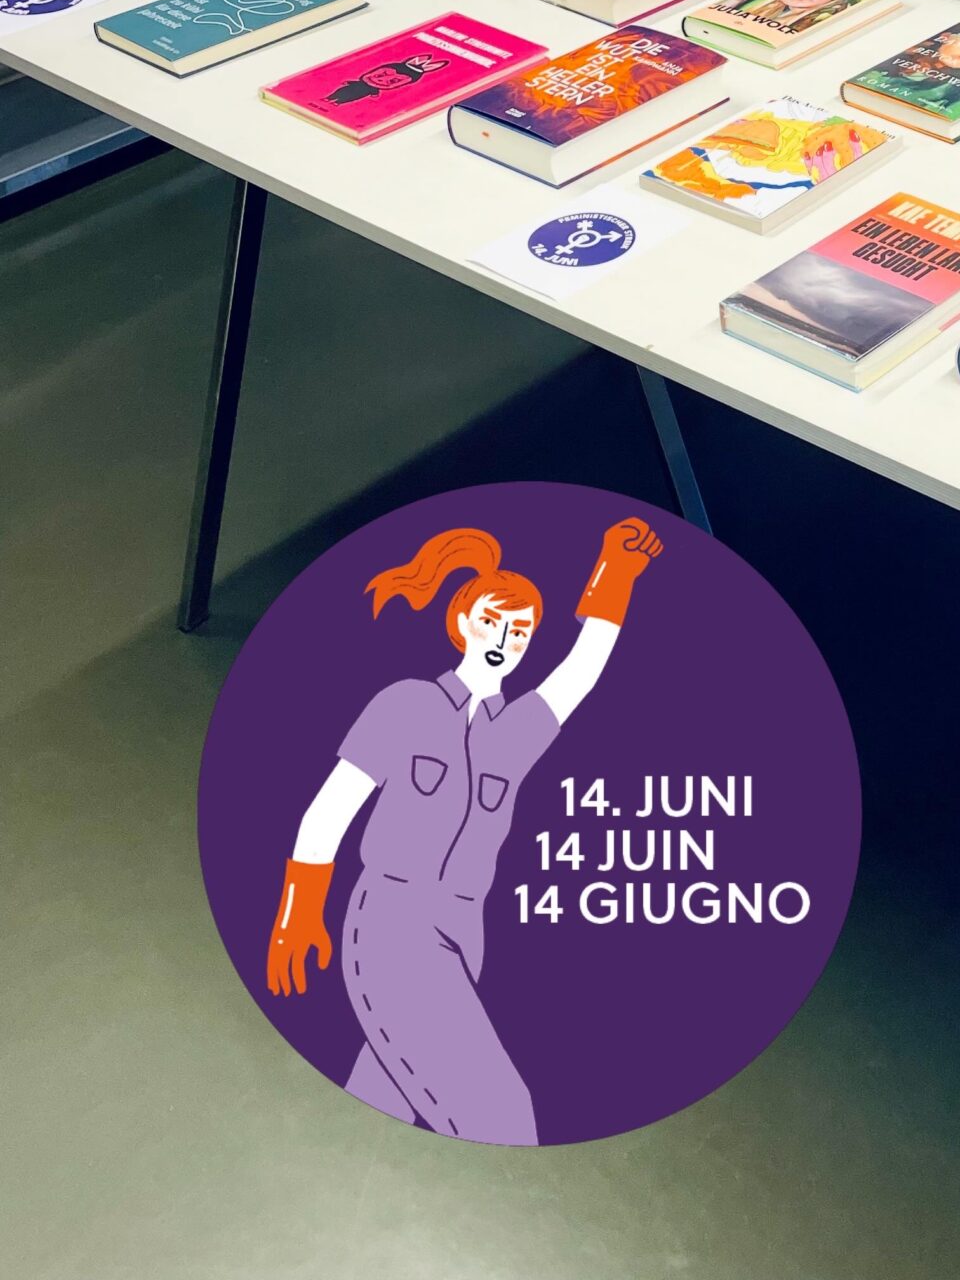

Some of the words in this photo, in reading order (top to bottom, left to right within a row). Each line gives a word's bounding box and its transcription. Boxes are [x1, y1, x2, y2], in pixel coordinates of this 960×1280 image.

[708, 4, 751, 20] JULIA
[754, 15, 800, 36] WOLF
[592, 39, 639, 61] WUT
[633, 38, 671, 57] DIE
[586, 52, 624, 70] IST
[634, 56, 679, 77] KAMPMANN
[662, 61, 684, 73] ANJA
[541, 66, 615, 98] HELLER
[579, 64, 616, 82] EIN
[524, 77, 595, 107] STERN
[857, 75, 913, 98] ROMAN
[886, 201, 926, 222] KAE
[851, 218, 884, 242] EIN
[877, 228, 934, 261] LEBEN
[544, 254, 579, 266] JUNI
[851, 241, 939, 282] GESUCHT
